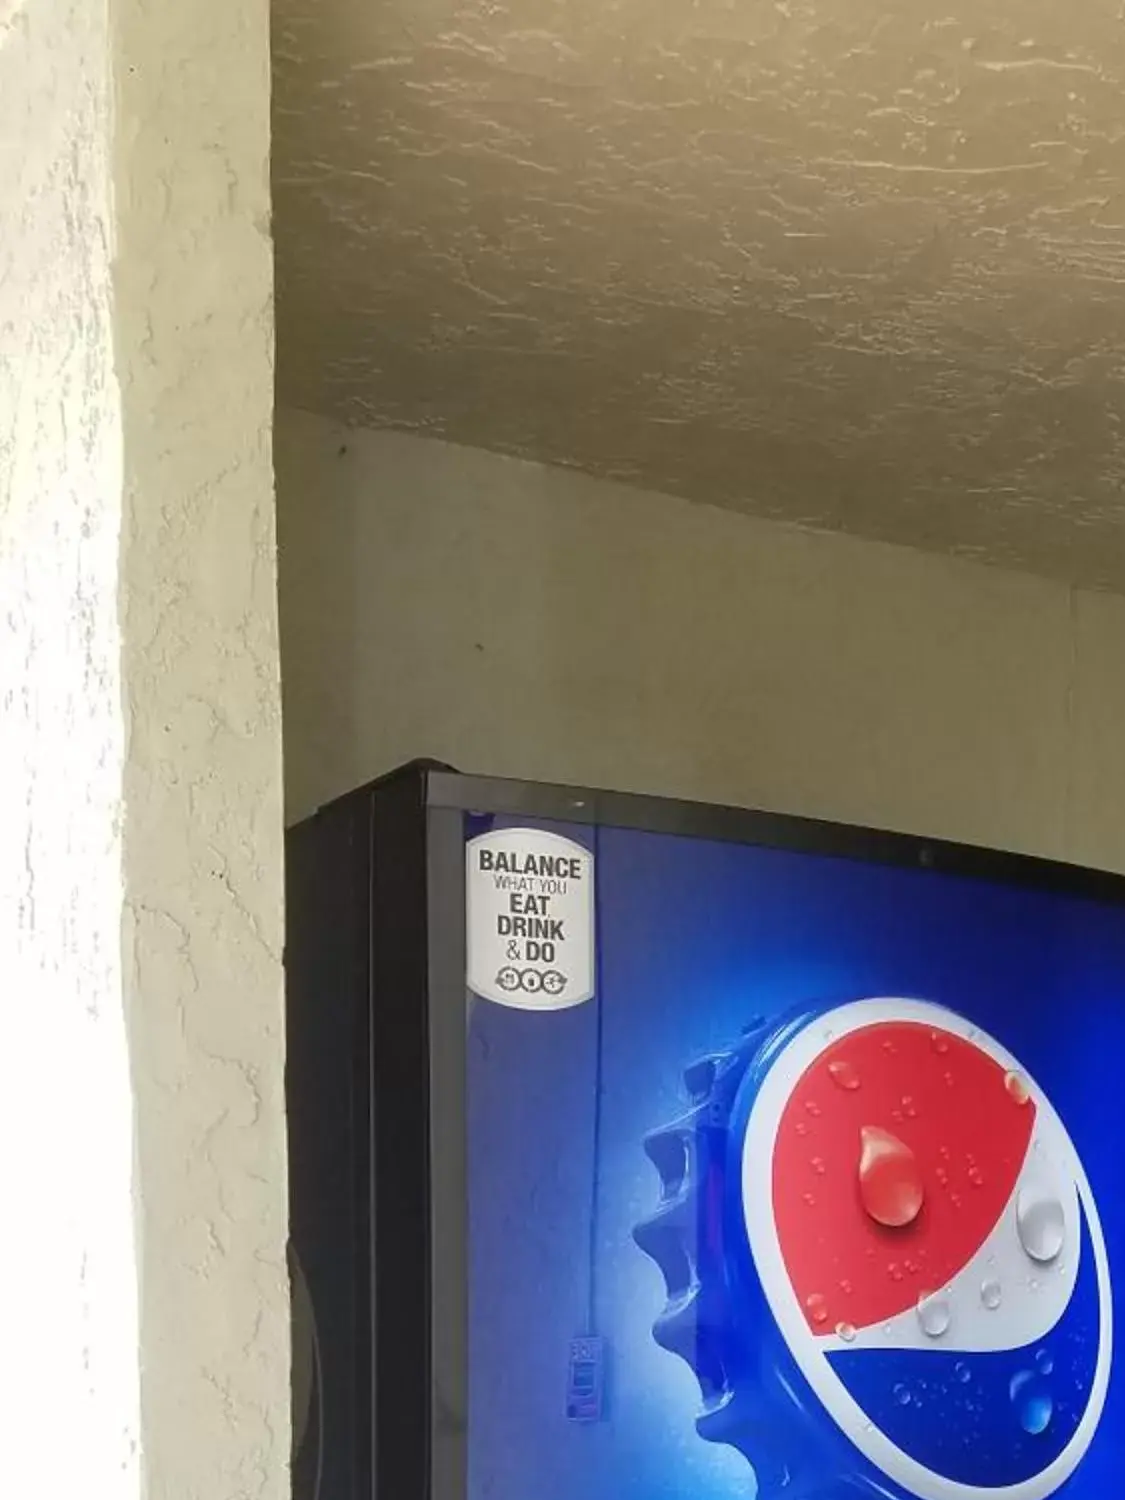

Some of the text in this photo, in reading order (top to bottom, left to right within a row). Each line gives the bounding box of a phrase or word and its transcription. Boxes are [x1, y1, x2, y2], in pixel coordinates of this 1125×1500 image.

[479, 849, 582, 880] BALANCE
[493, 875, 567, 895] WHAT YOU
[497, 914, 565, 941] DRINK
[506, 939, 555, 963] & DO
